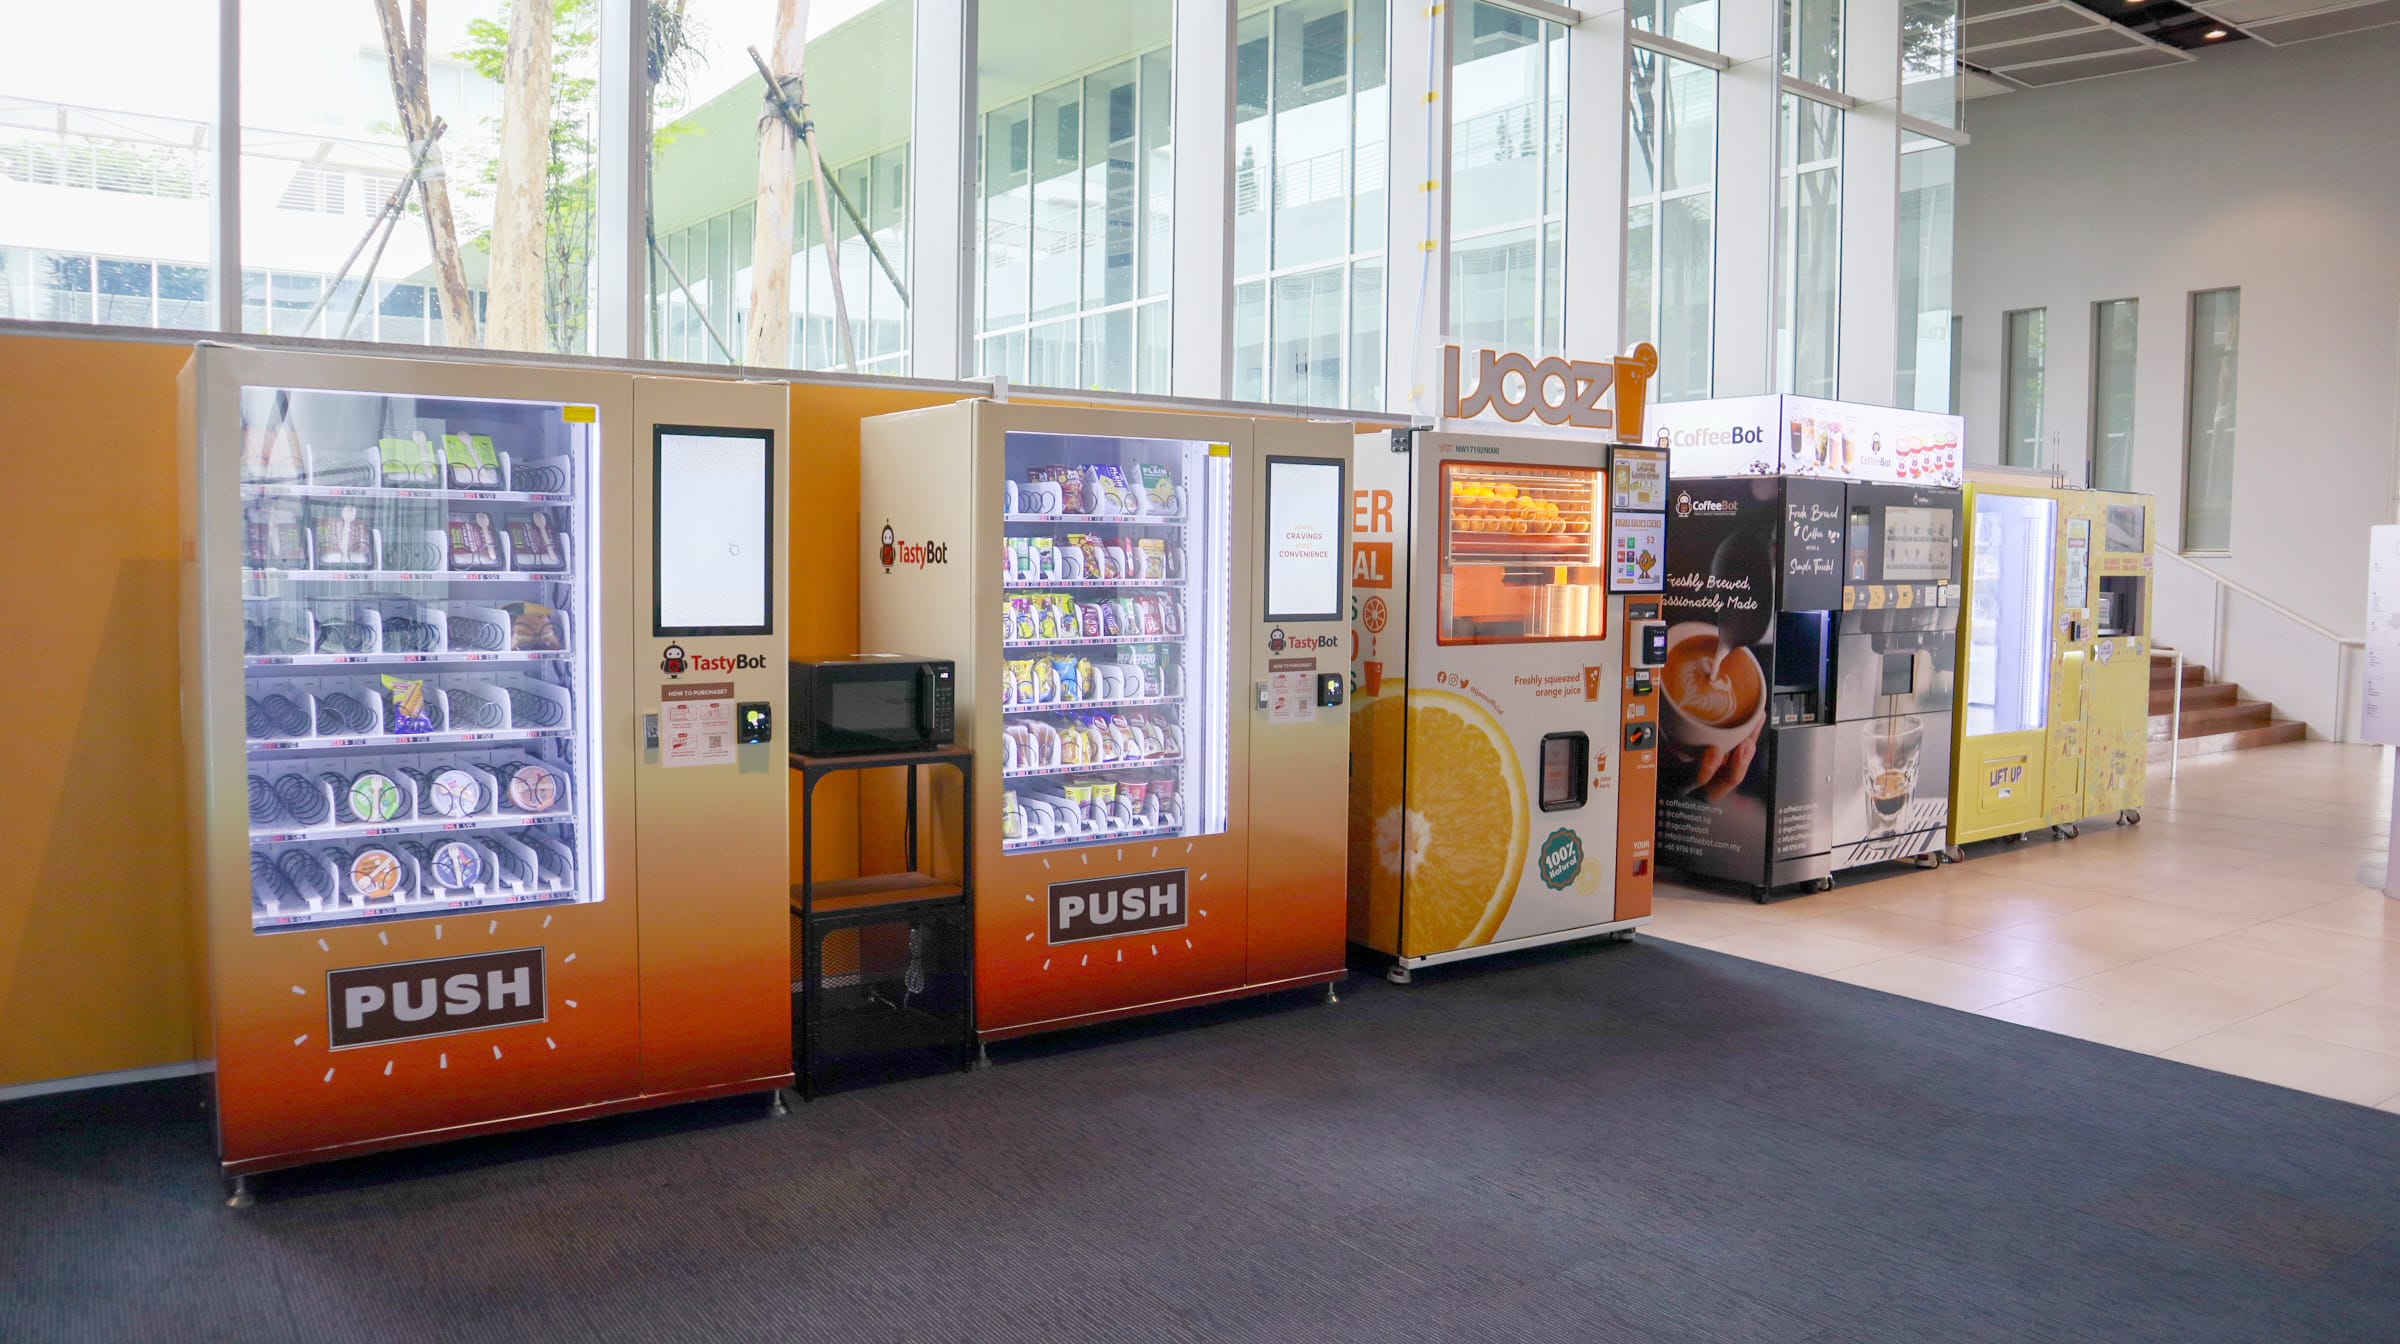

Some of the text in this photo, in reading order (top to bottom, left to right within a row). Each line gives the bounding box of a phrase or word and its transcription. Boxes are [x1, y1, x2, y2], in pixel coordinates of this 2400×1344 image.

[1443, 345, 1613, 429] IJOOZ
[1674, 425, 1764, 447] CoffeeBot
[1860, 456, 1891, 467] CoffeeBot
[1693, 500, 1739, 511] CoffeeBot
[1788, 504, 1807, 522] Fresh
[1286, 532, 1323, 540] CRAVINGS
[1802, 525, 1824, 542] Coffee
[898, 539, 948, 570] TastyBot
[1279, 550, 1329, 558] CONVENIENCE
[1706, 575, 1751, 591] Brewed,
[1662, 593, 1759, 613] assionately Made
[1288, 635, 1338, 651] TastyBot
[691, 654, 766, 674] TastyBot
[1514, 673, 1581, 687] Freshly squeezed
[693, 688, 728, 696] PURCHASE?
[1535, 686, 1581, 699] orange juice
[1990, 765, 2023, 787] LIFT UP
[1633, 840, 1650, 849] YOUR
[1546, 841, 1576, 869] 100%
[1549, 855, 1577, 879] Natural
[1058, 883, 1178, 929] PUSH
[344, 966, 531, 1029] PUSH
